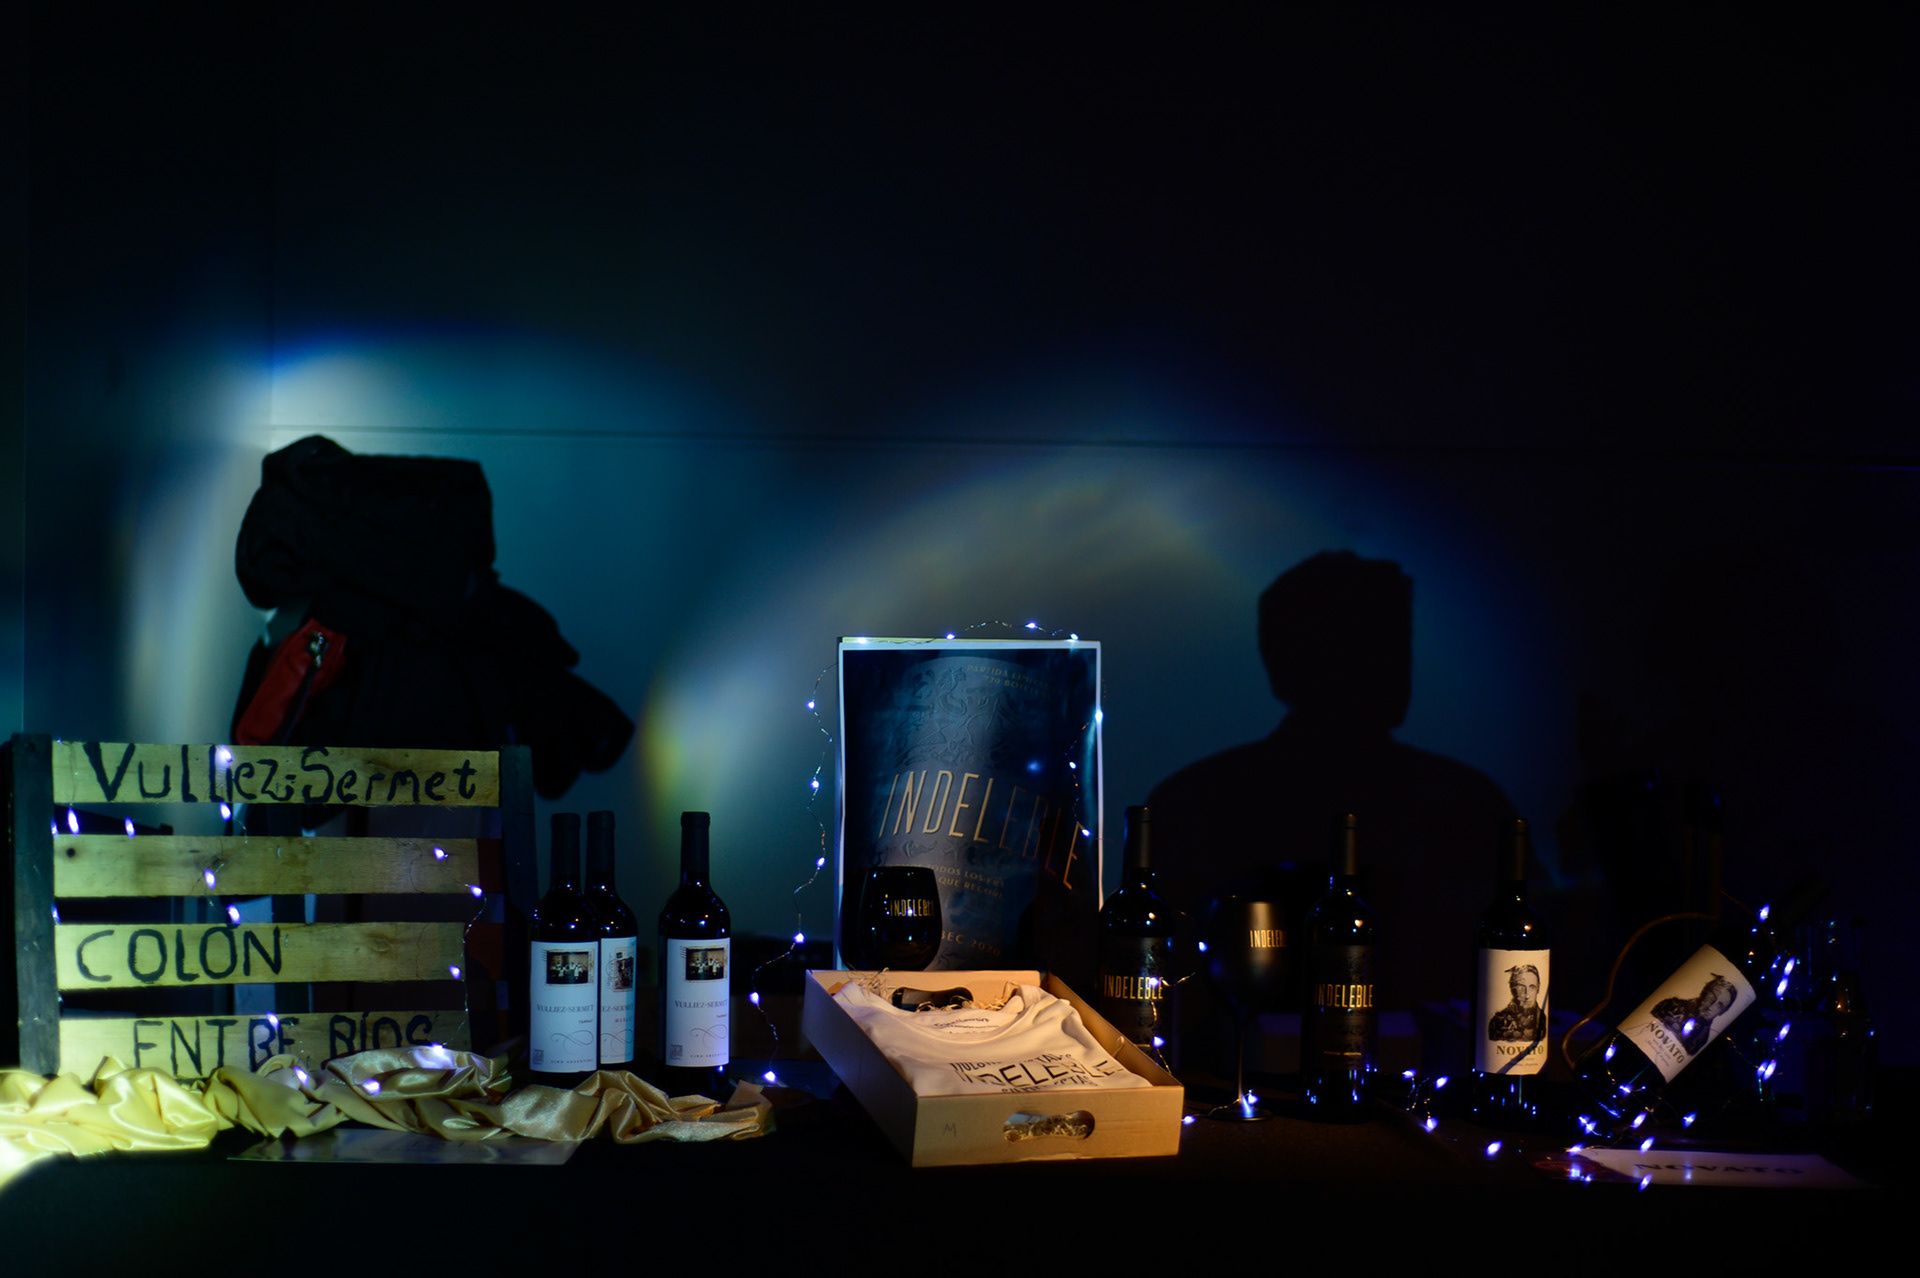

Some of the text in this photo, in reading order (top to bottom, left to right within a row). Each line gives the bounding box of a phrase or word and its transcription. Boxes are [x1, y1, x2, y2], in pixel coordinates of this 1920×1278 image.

[878, 770, 1086, 891] INDELEBLE
[1103, 974, 1164, 1000] INDELEBLE
[1313, 983, 1374, 1008] INDELEBLE
[1646, 1020, 1685, 1064] NOVATO
[1635, 1163, 1804, 1175] NOVATO
